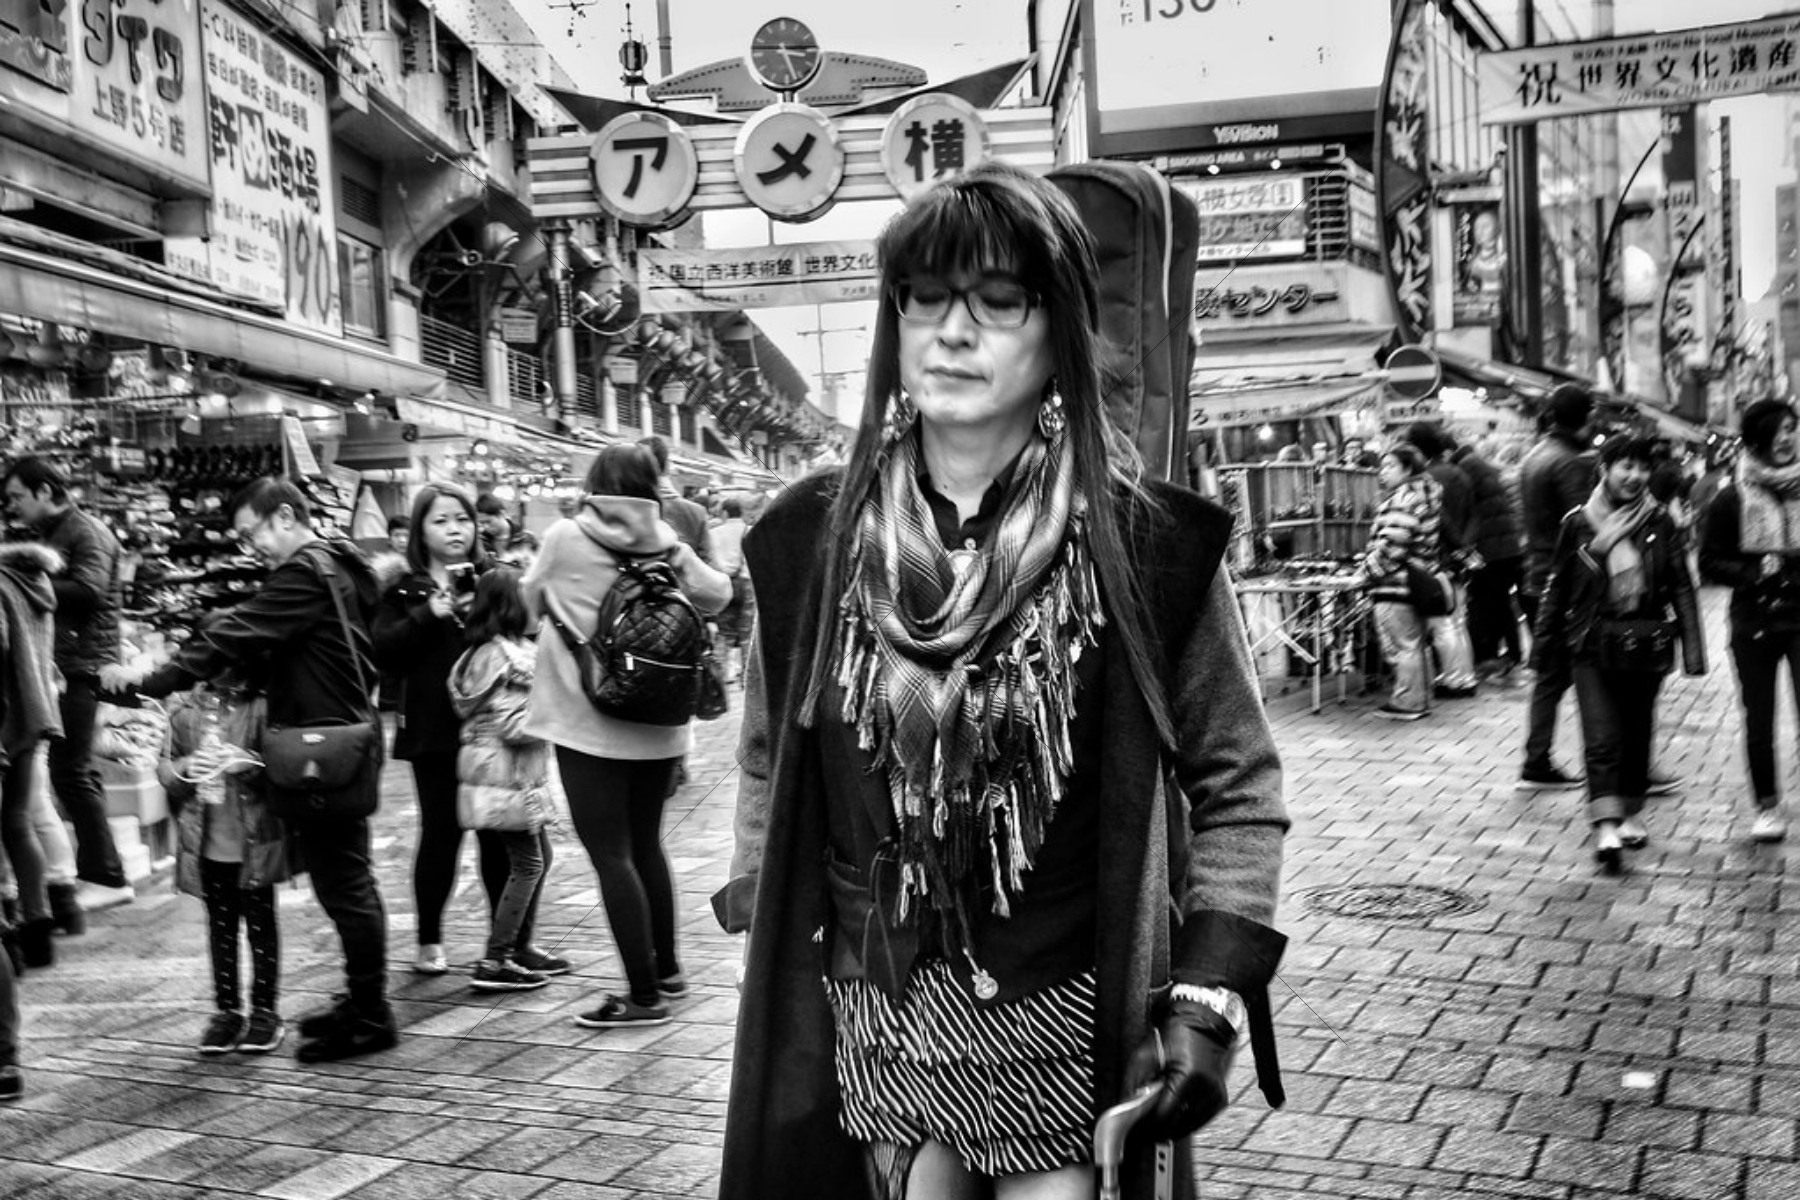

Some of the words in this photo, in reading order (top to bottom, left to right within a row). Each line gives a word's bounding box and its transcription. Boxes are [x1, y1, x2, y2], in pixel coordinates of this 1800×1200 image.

[1516, 61, 1562, 107] 祝
[670, 258, 794, 280] 国立西洋美術館
[805, 253, 875, 273] 世界文化
